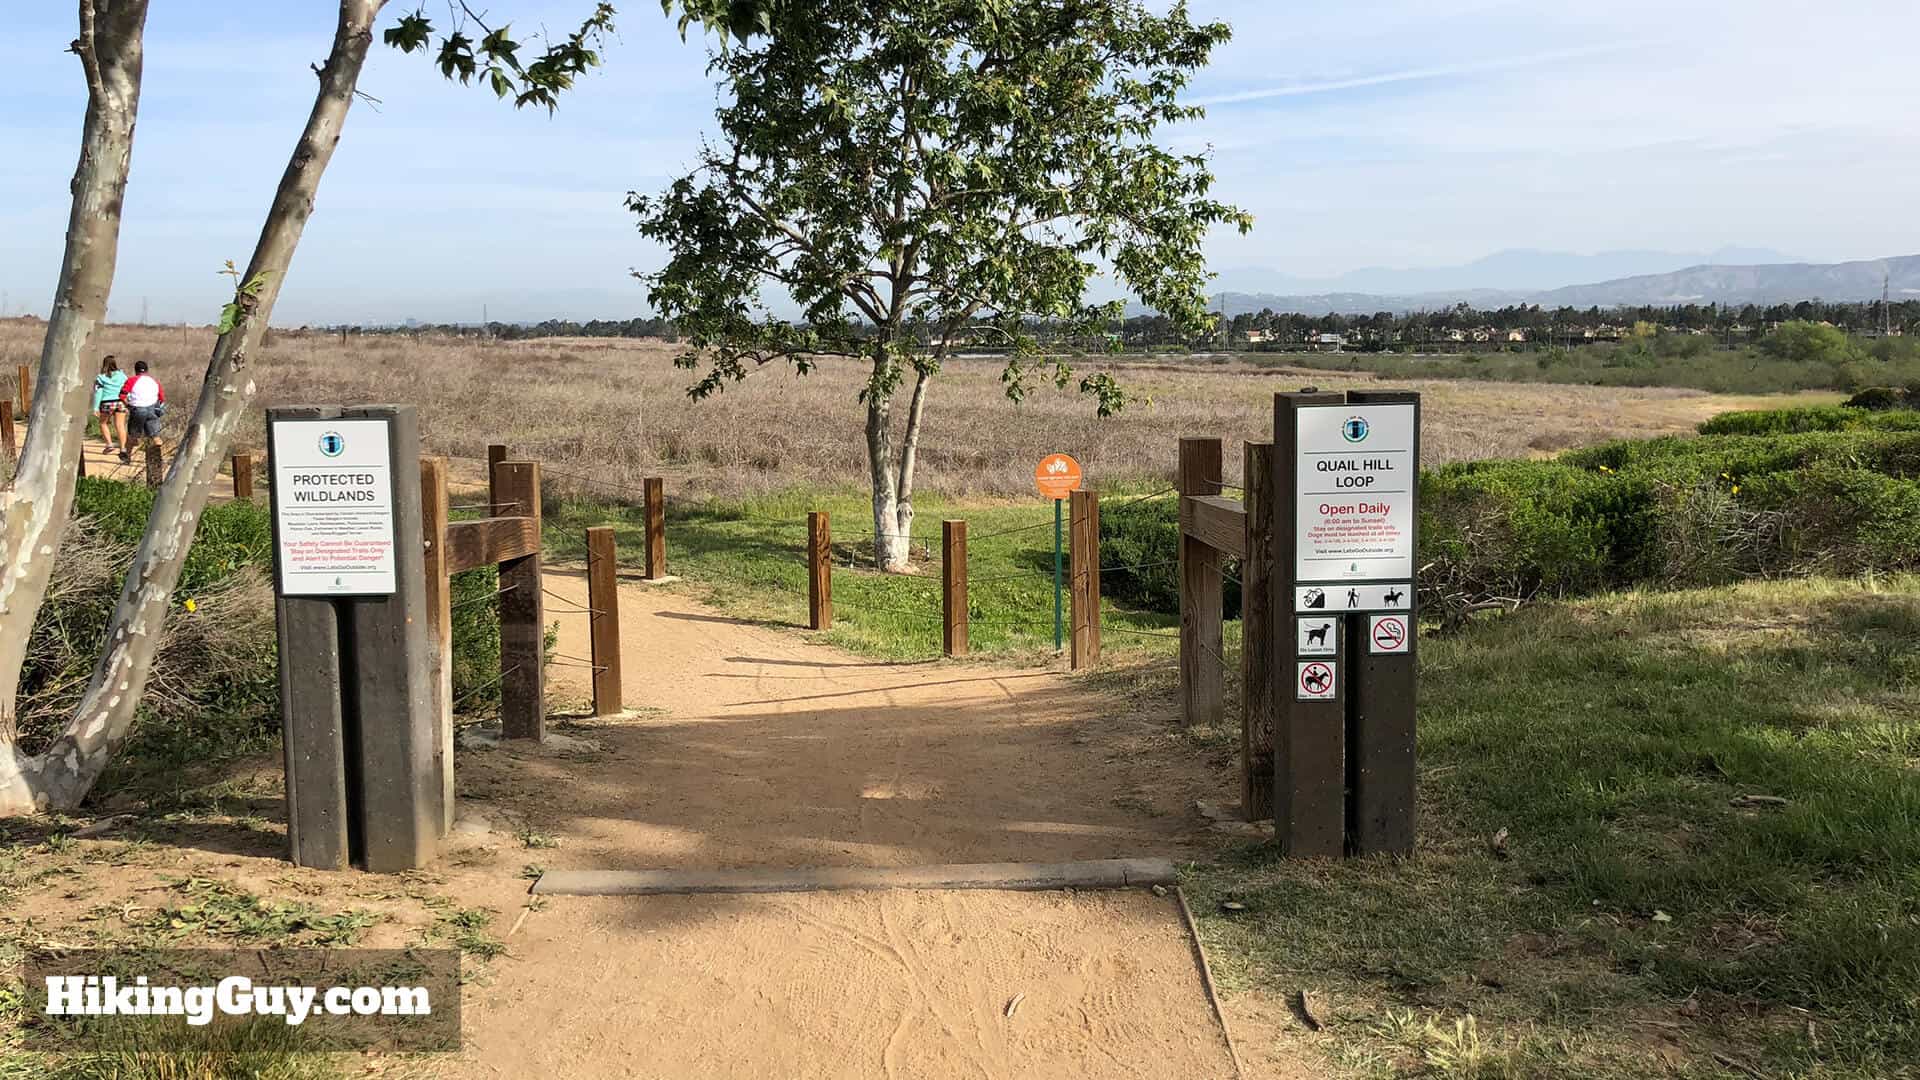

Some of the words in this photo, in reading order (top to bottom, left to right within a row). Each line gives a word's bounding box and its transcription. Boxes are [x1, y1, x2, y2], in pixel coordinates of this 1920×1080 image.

[1317, 460, 1360, 472] QUAIL
[1364, 459, 1393, 470] HILL
[293, 474, 374, 485] PROTECTED
[1336, 476, 1374, 488] LOOP
[294, 491, 375, 502] WILDLANDS
[1320, 504, 1354, 516] Open
[1359, 503, 1390, 516] Daily
